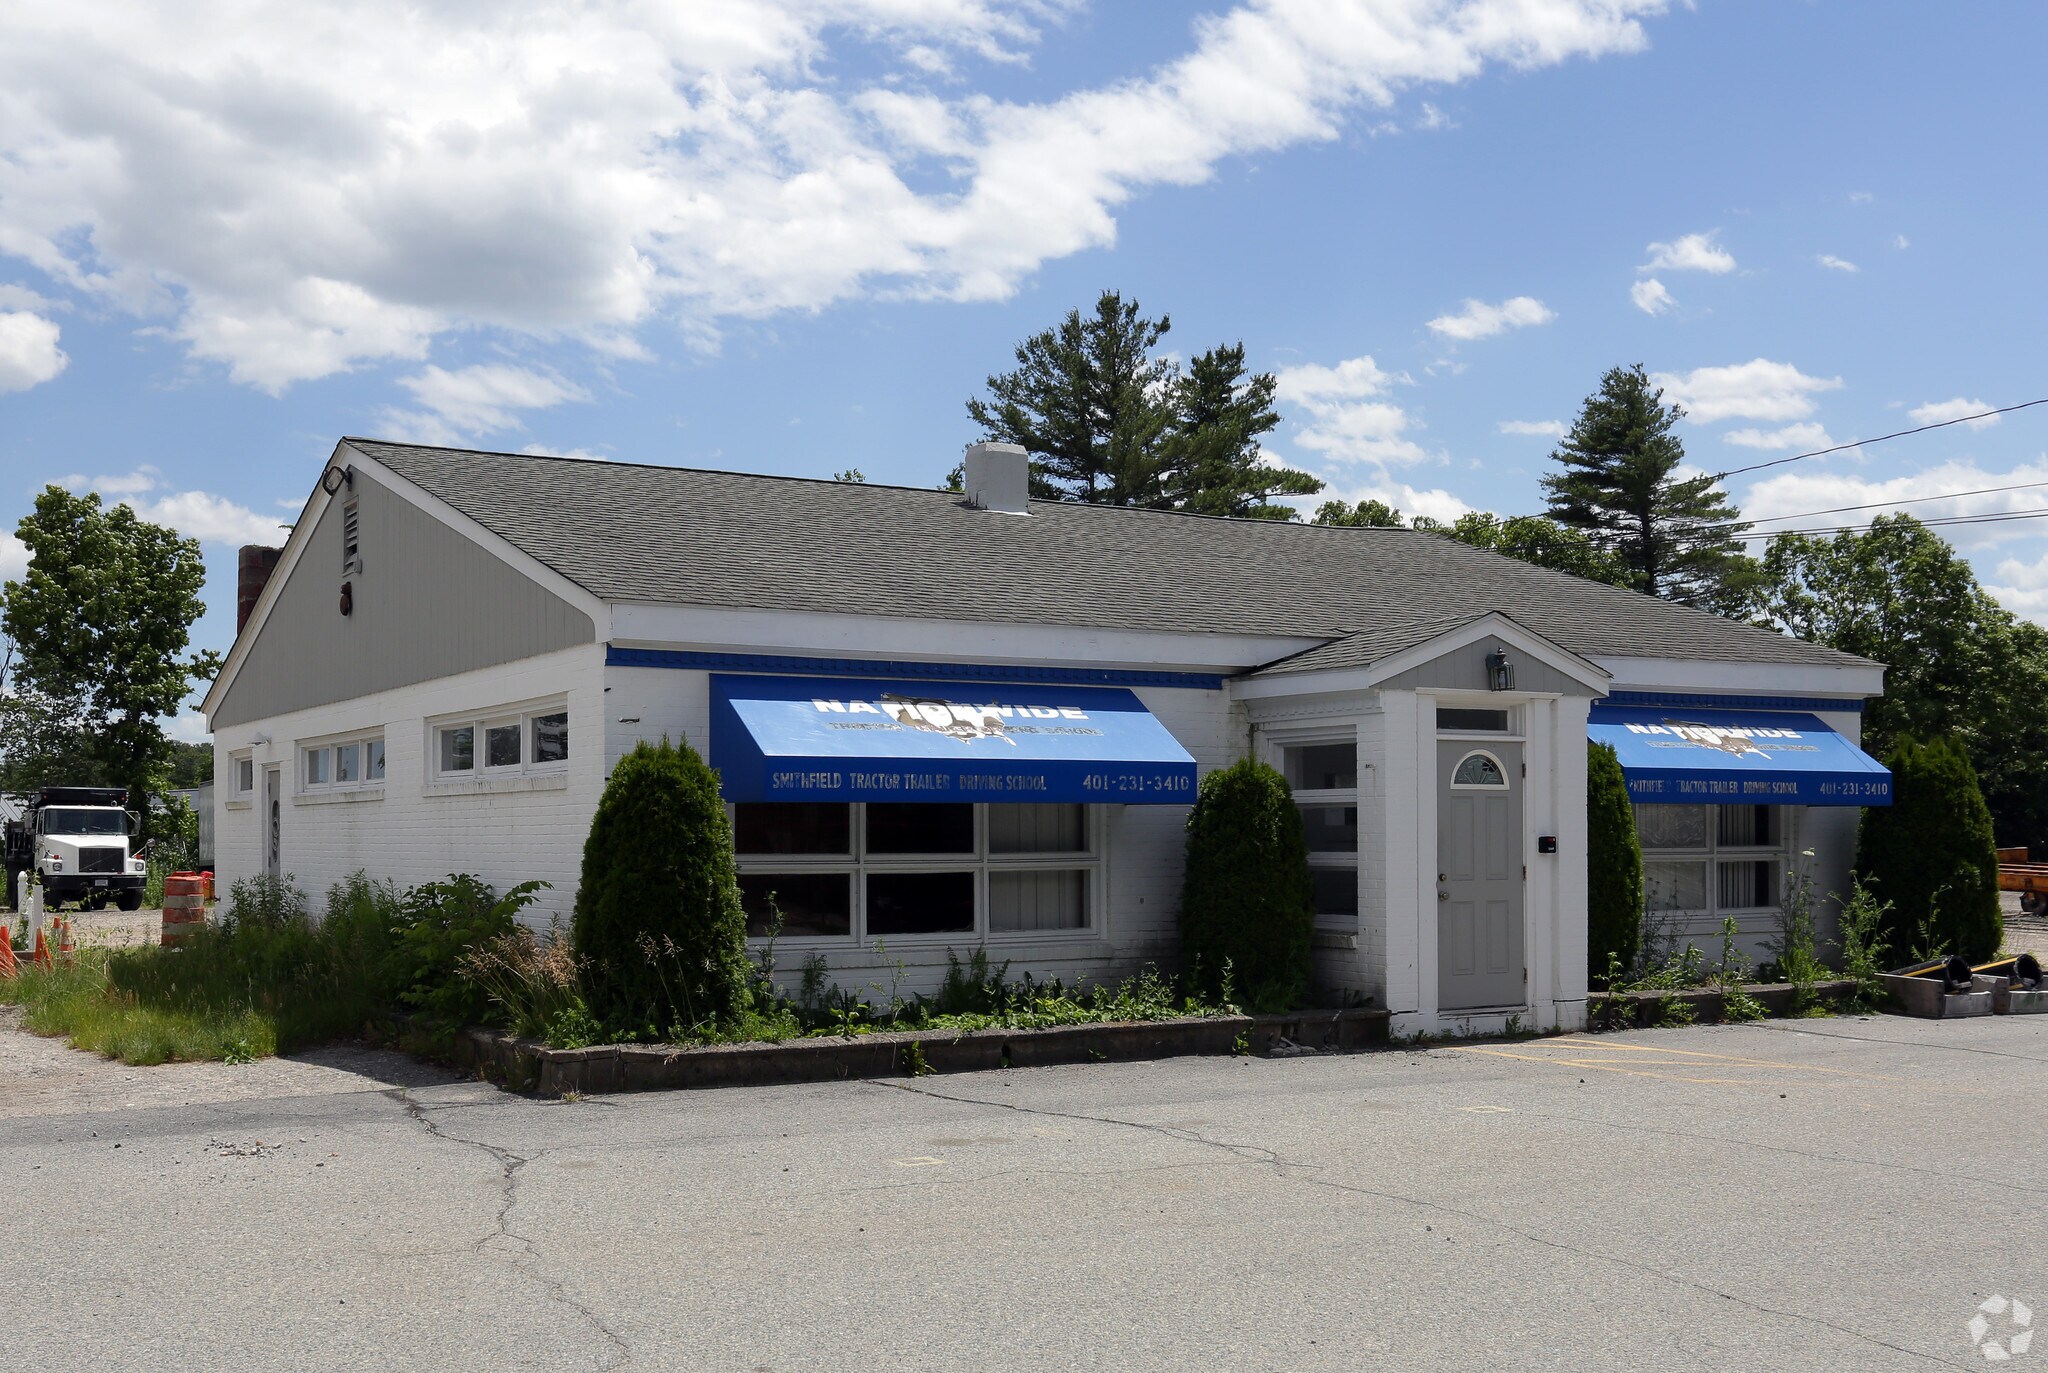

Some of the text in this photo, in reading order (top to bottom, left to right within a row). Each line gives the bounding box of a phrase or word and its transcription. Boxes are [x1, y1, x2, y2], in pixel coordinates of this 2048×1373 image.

[811, 698, 1089, 728] NATIONWIDE
[772, 772, 1190, 791] SMITHFIELD TRACTOR TRAILER DRIVING SCHOOL 401-231-3410
[1709, 781, 1738, 794] TRAILER
[1744, 781, 1771, 794] DRIVING
[1772, 782, 1798, 794] SCHOOL
[1820, 783, 1888, 795] 401-231-3410
